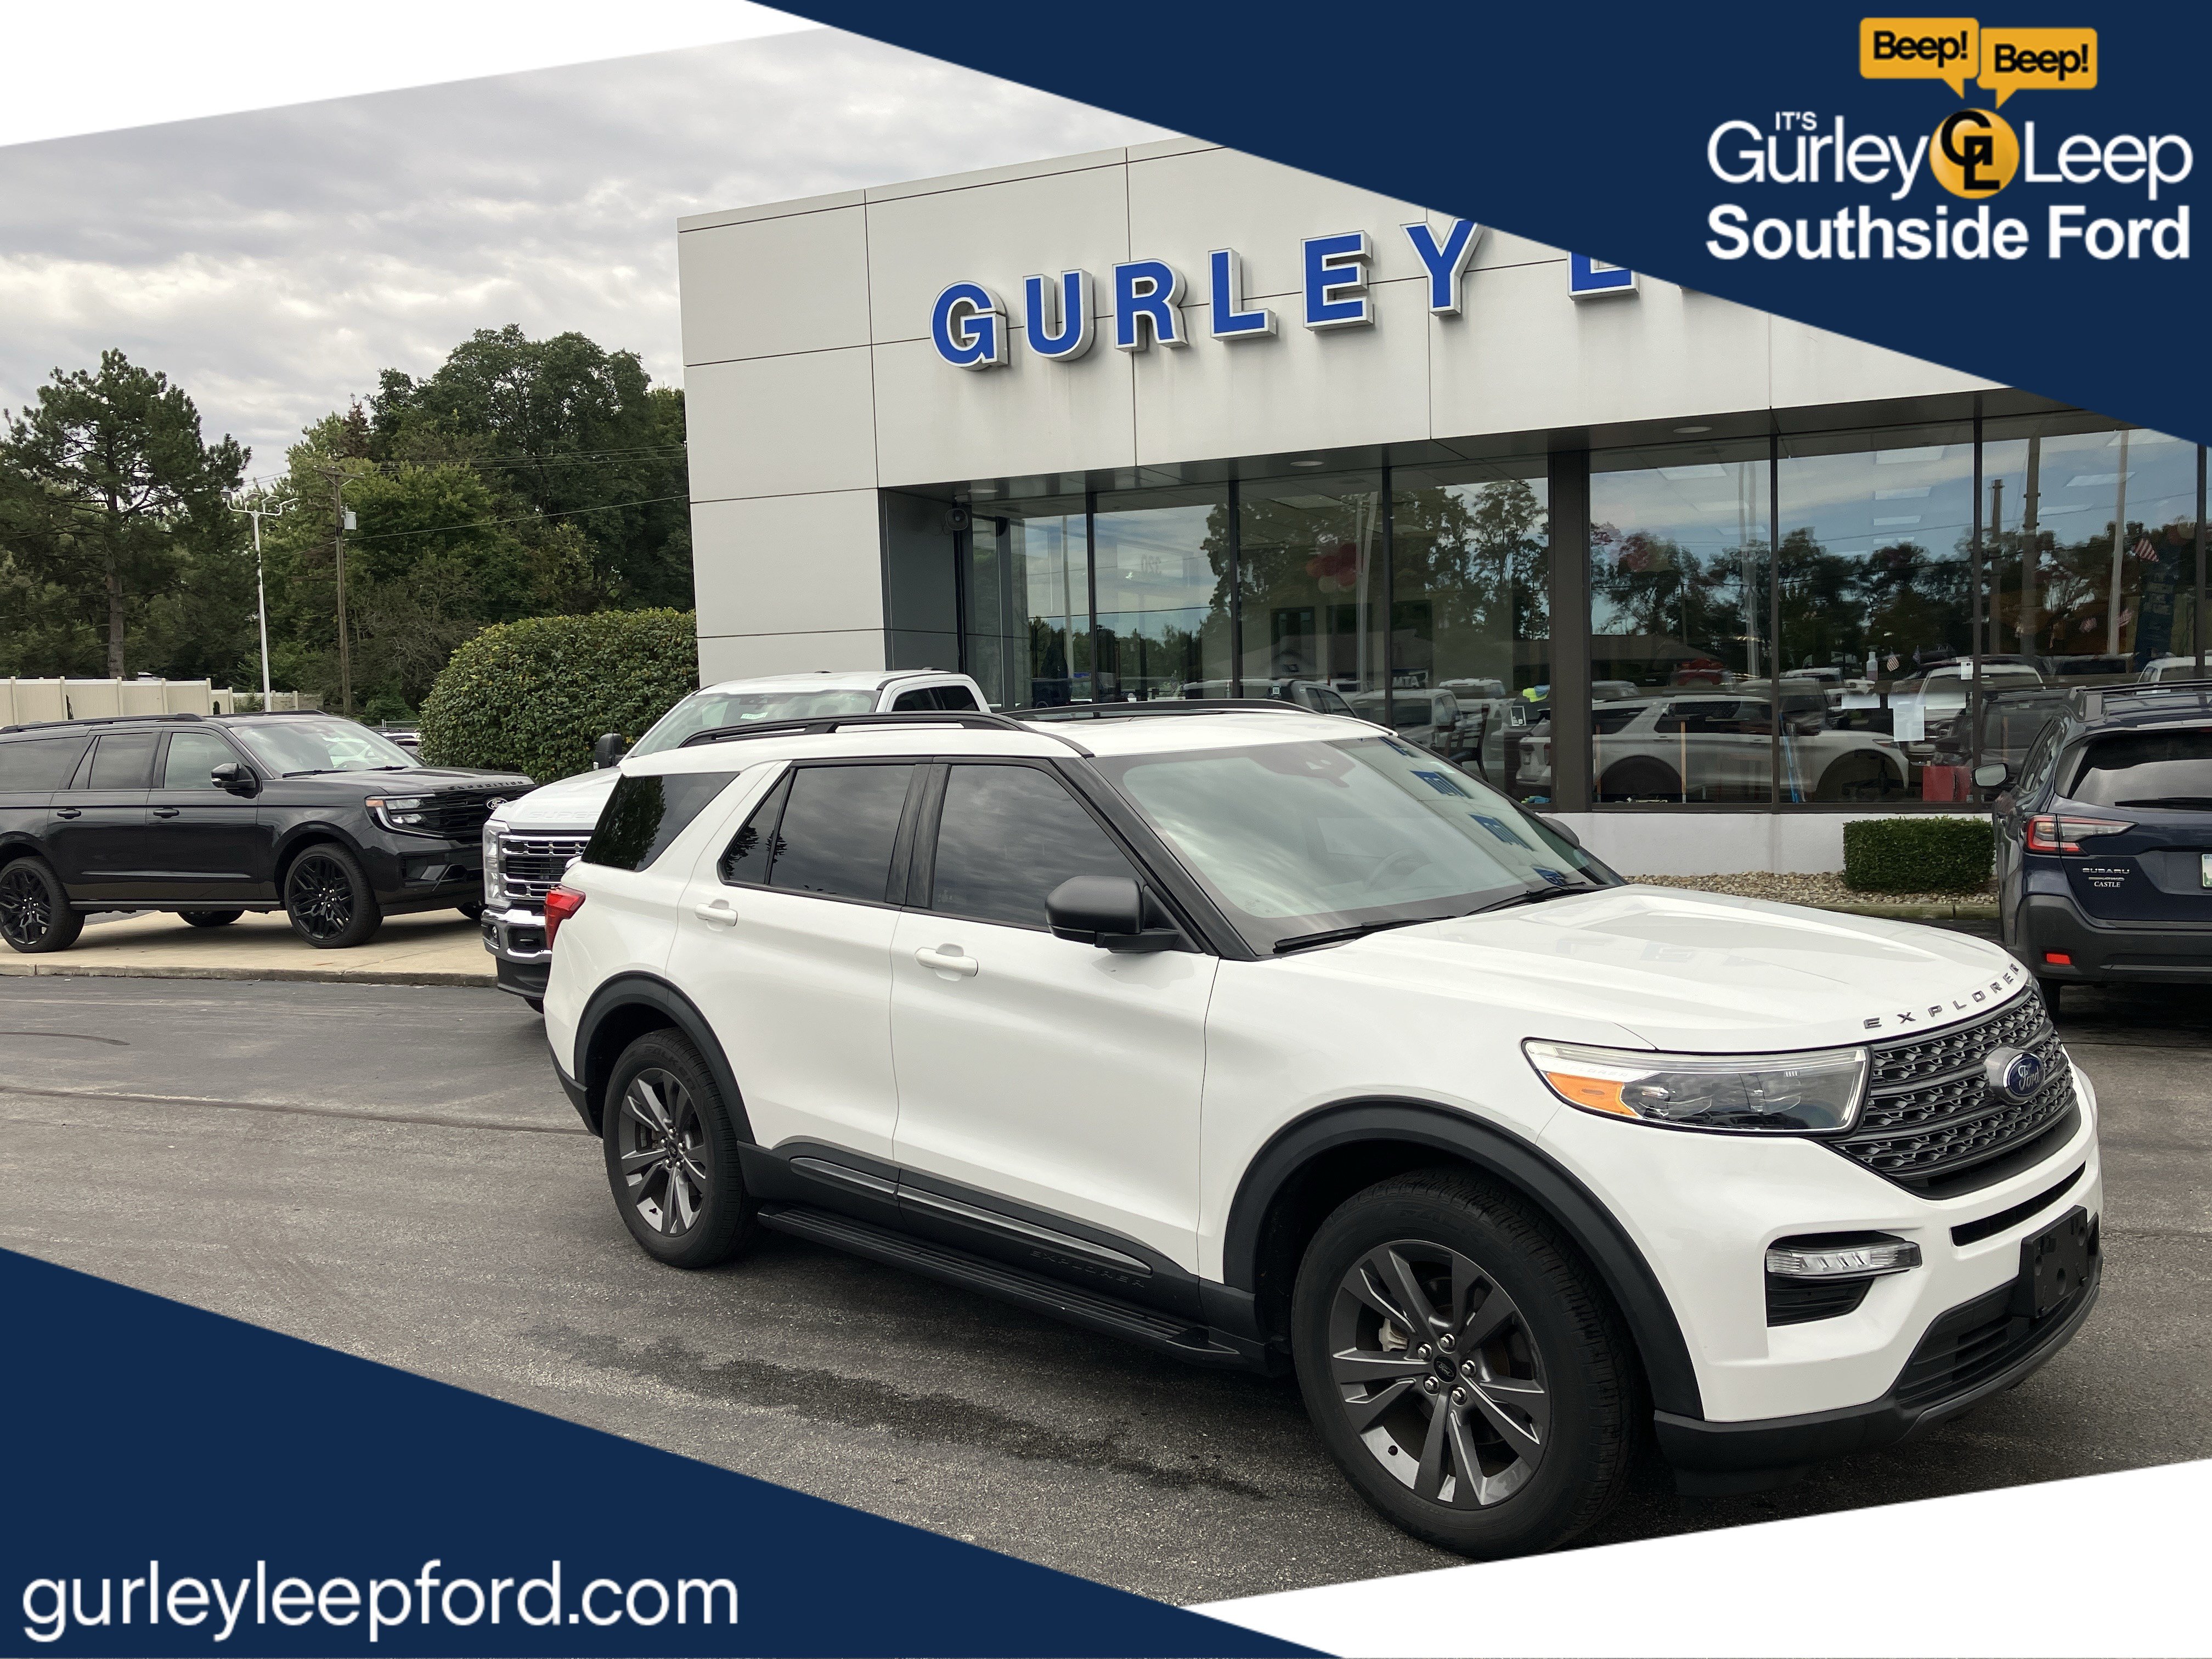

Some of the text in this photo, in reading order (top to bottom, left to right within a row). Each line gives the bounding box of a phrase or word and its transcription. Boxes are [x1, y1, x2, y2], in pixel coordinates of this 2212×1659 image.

[929, 218, 1484, 371] GURLEY
[447, 781, 524, 791] EXPEDITION
[1863, 962, 2020, 1030] EXPLORER
[2018, 1062, 2040, 1091] Ford
